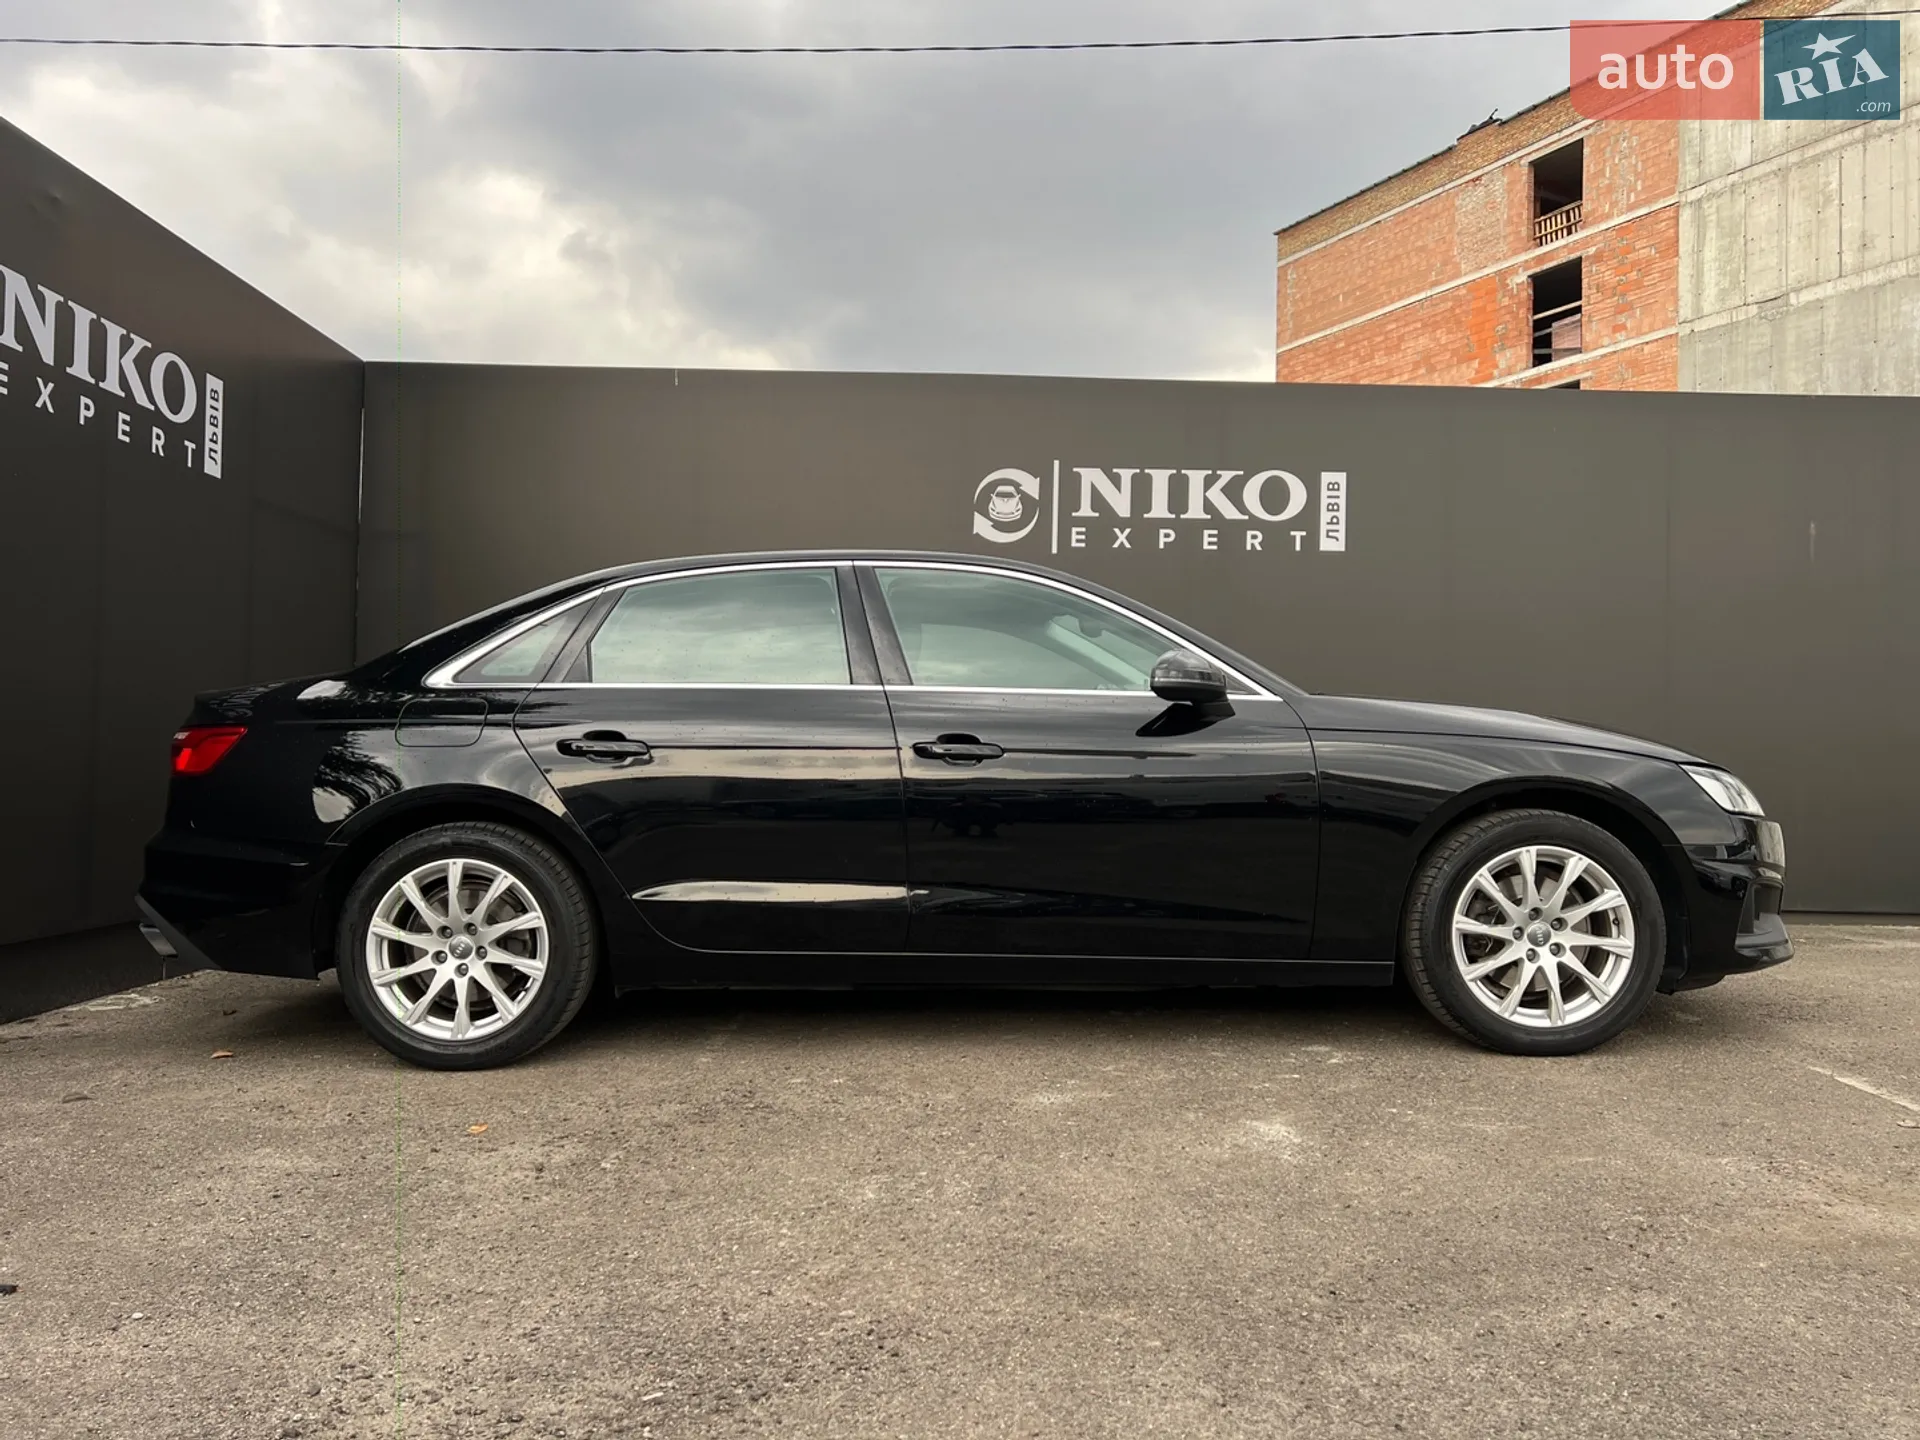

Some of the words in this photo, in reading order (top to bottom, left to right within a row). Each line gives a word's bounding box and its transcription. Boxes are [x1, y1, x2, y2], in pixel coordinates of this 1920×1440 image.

[0, 264, 198, 424] NIKO
[208, 387, 220, 466] ЛЬВІВ
[1071, 467, 1308, 521] NIKO
[1326, 480, 1341, 542] ЛЬВІВ
[1070, 527, 1307, 551] EXPERT
